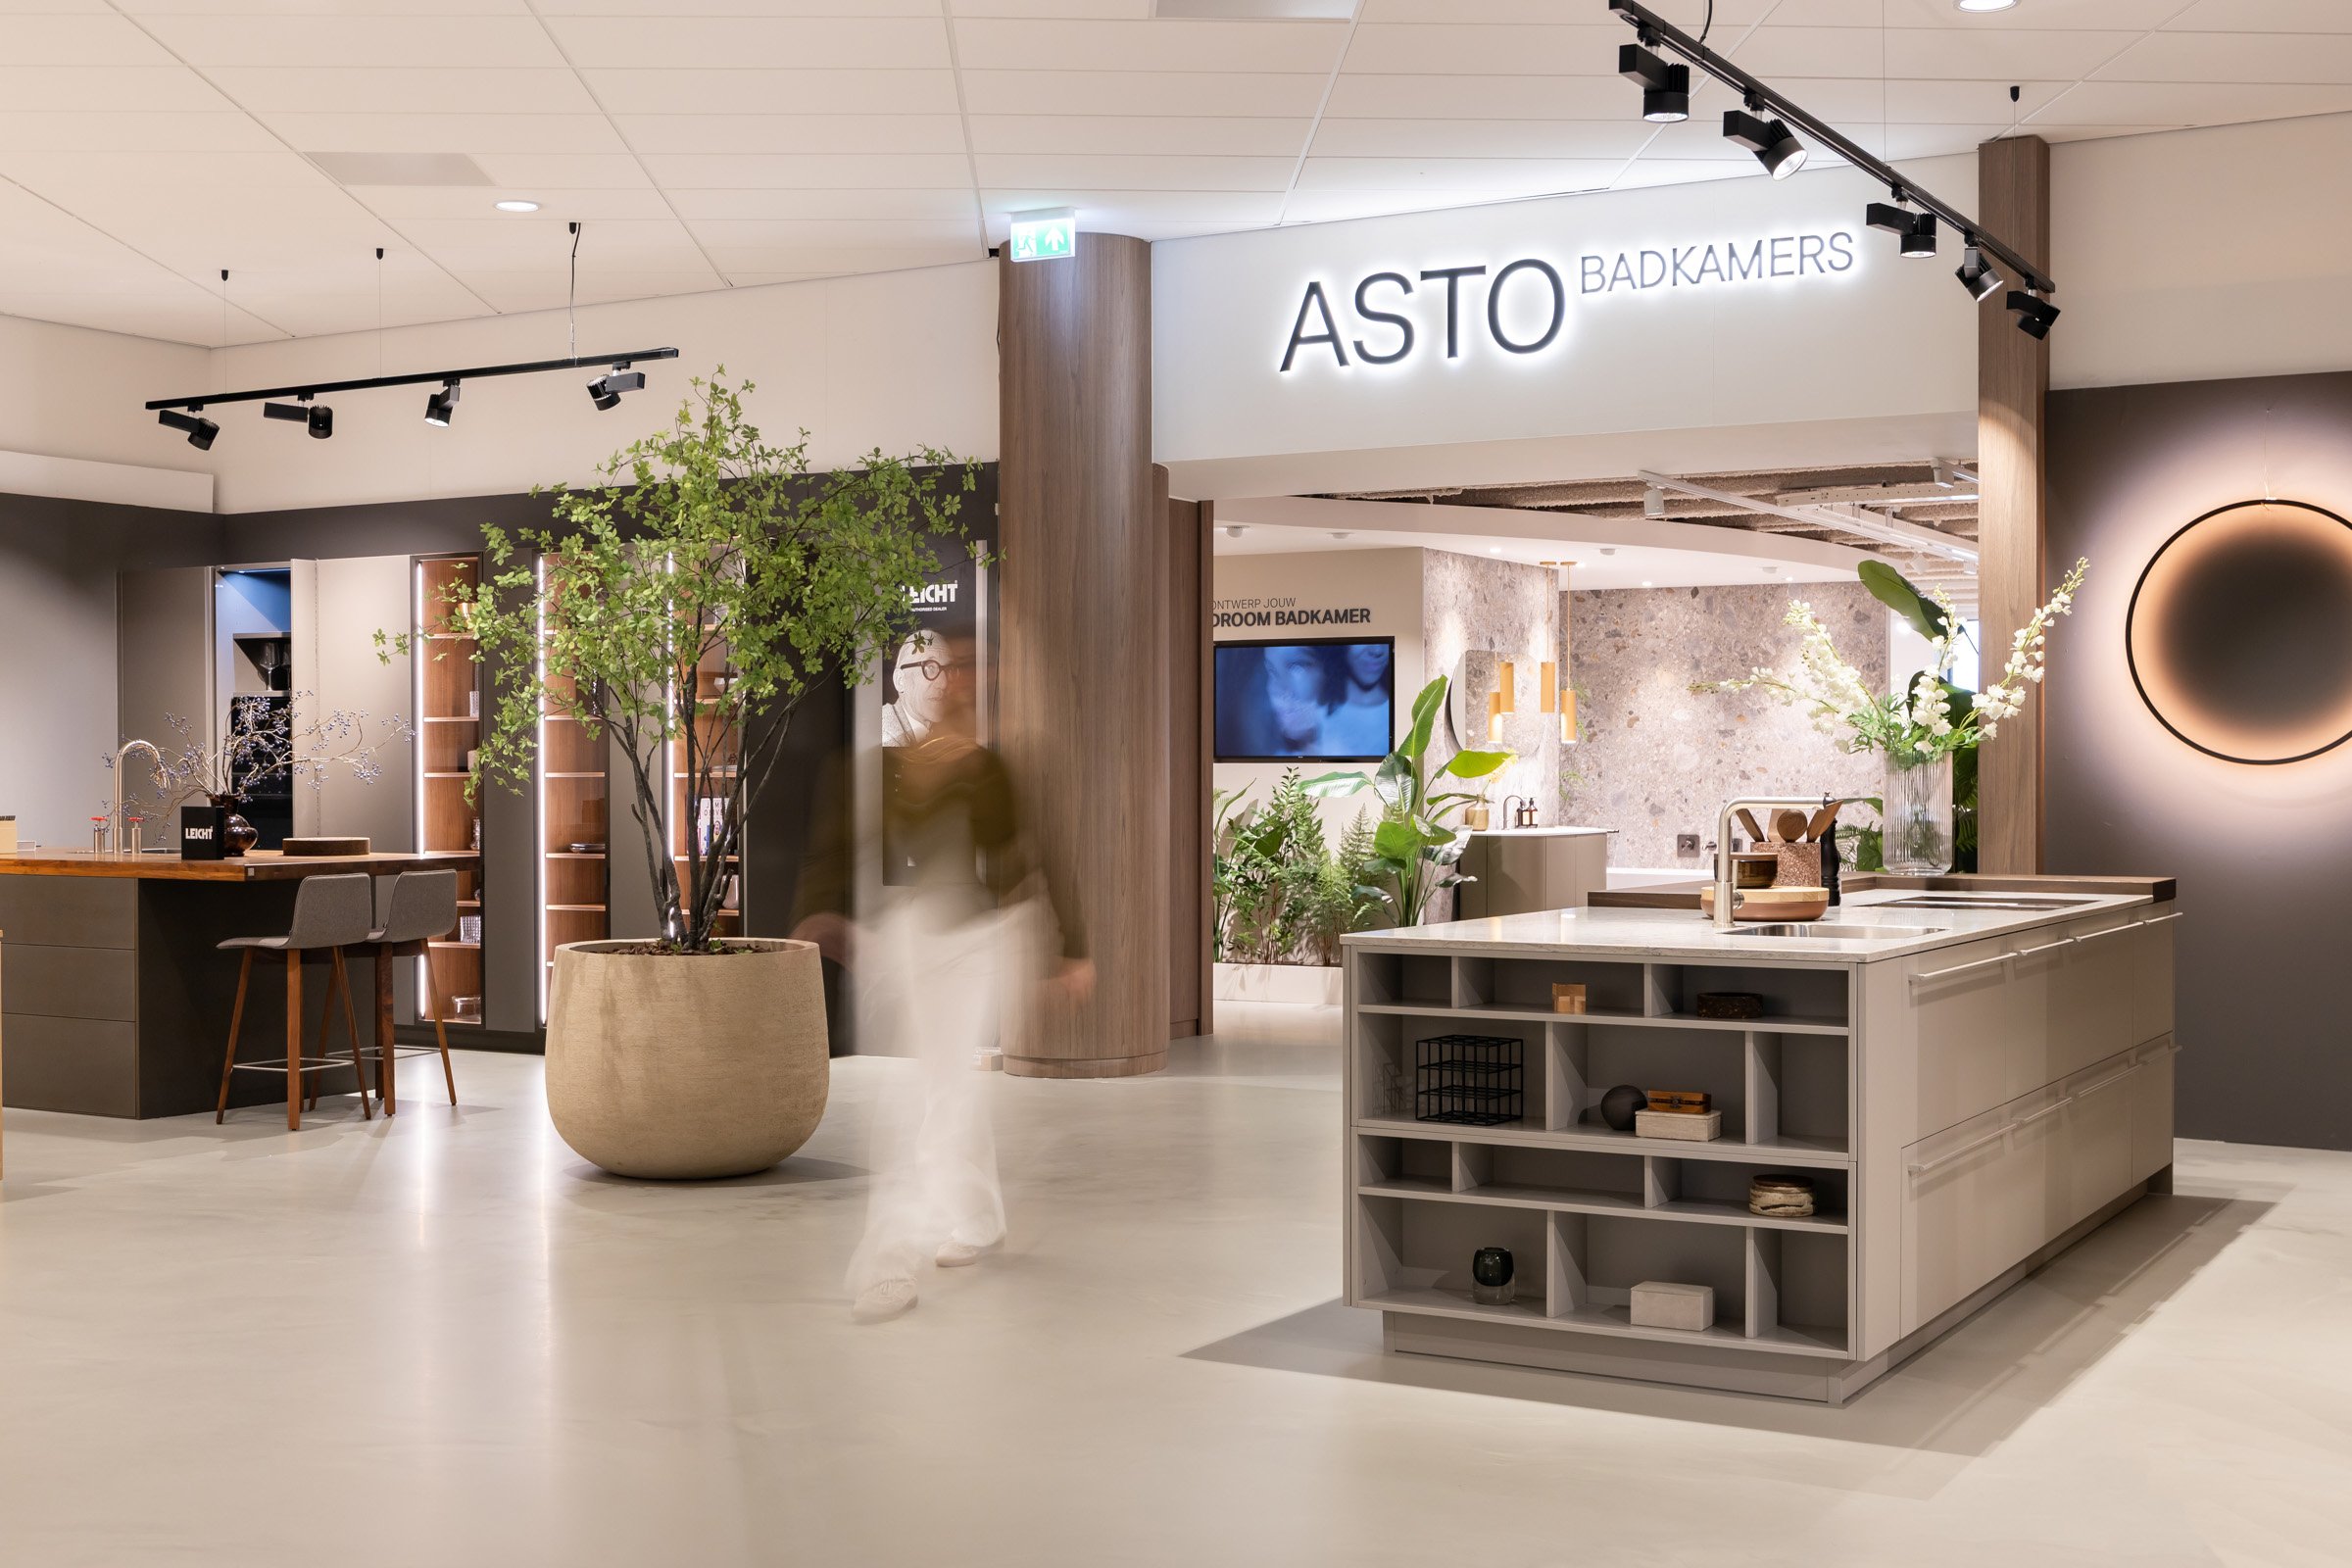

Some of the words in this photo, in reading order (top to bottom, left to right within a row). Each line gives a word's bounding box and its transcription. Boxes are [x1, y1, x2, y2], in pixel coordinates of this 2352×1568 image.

[1279, 257, 1566, 373] ASTO
[1580, 231, 1854, 294] BADKAMERS
[1263, 597, 1297, 609] JOUW
[1212, 612, 1271, 627] DROOM
[1275, 608, 1371, 626] BADKAMER
[185, 827, 213, 840] LEICHT
